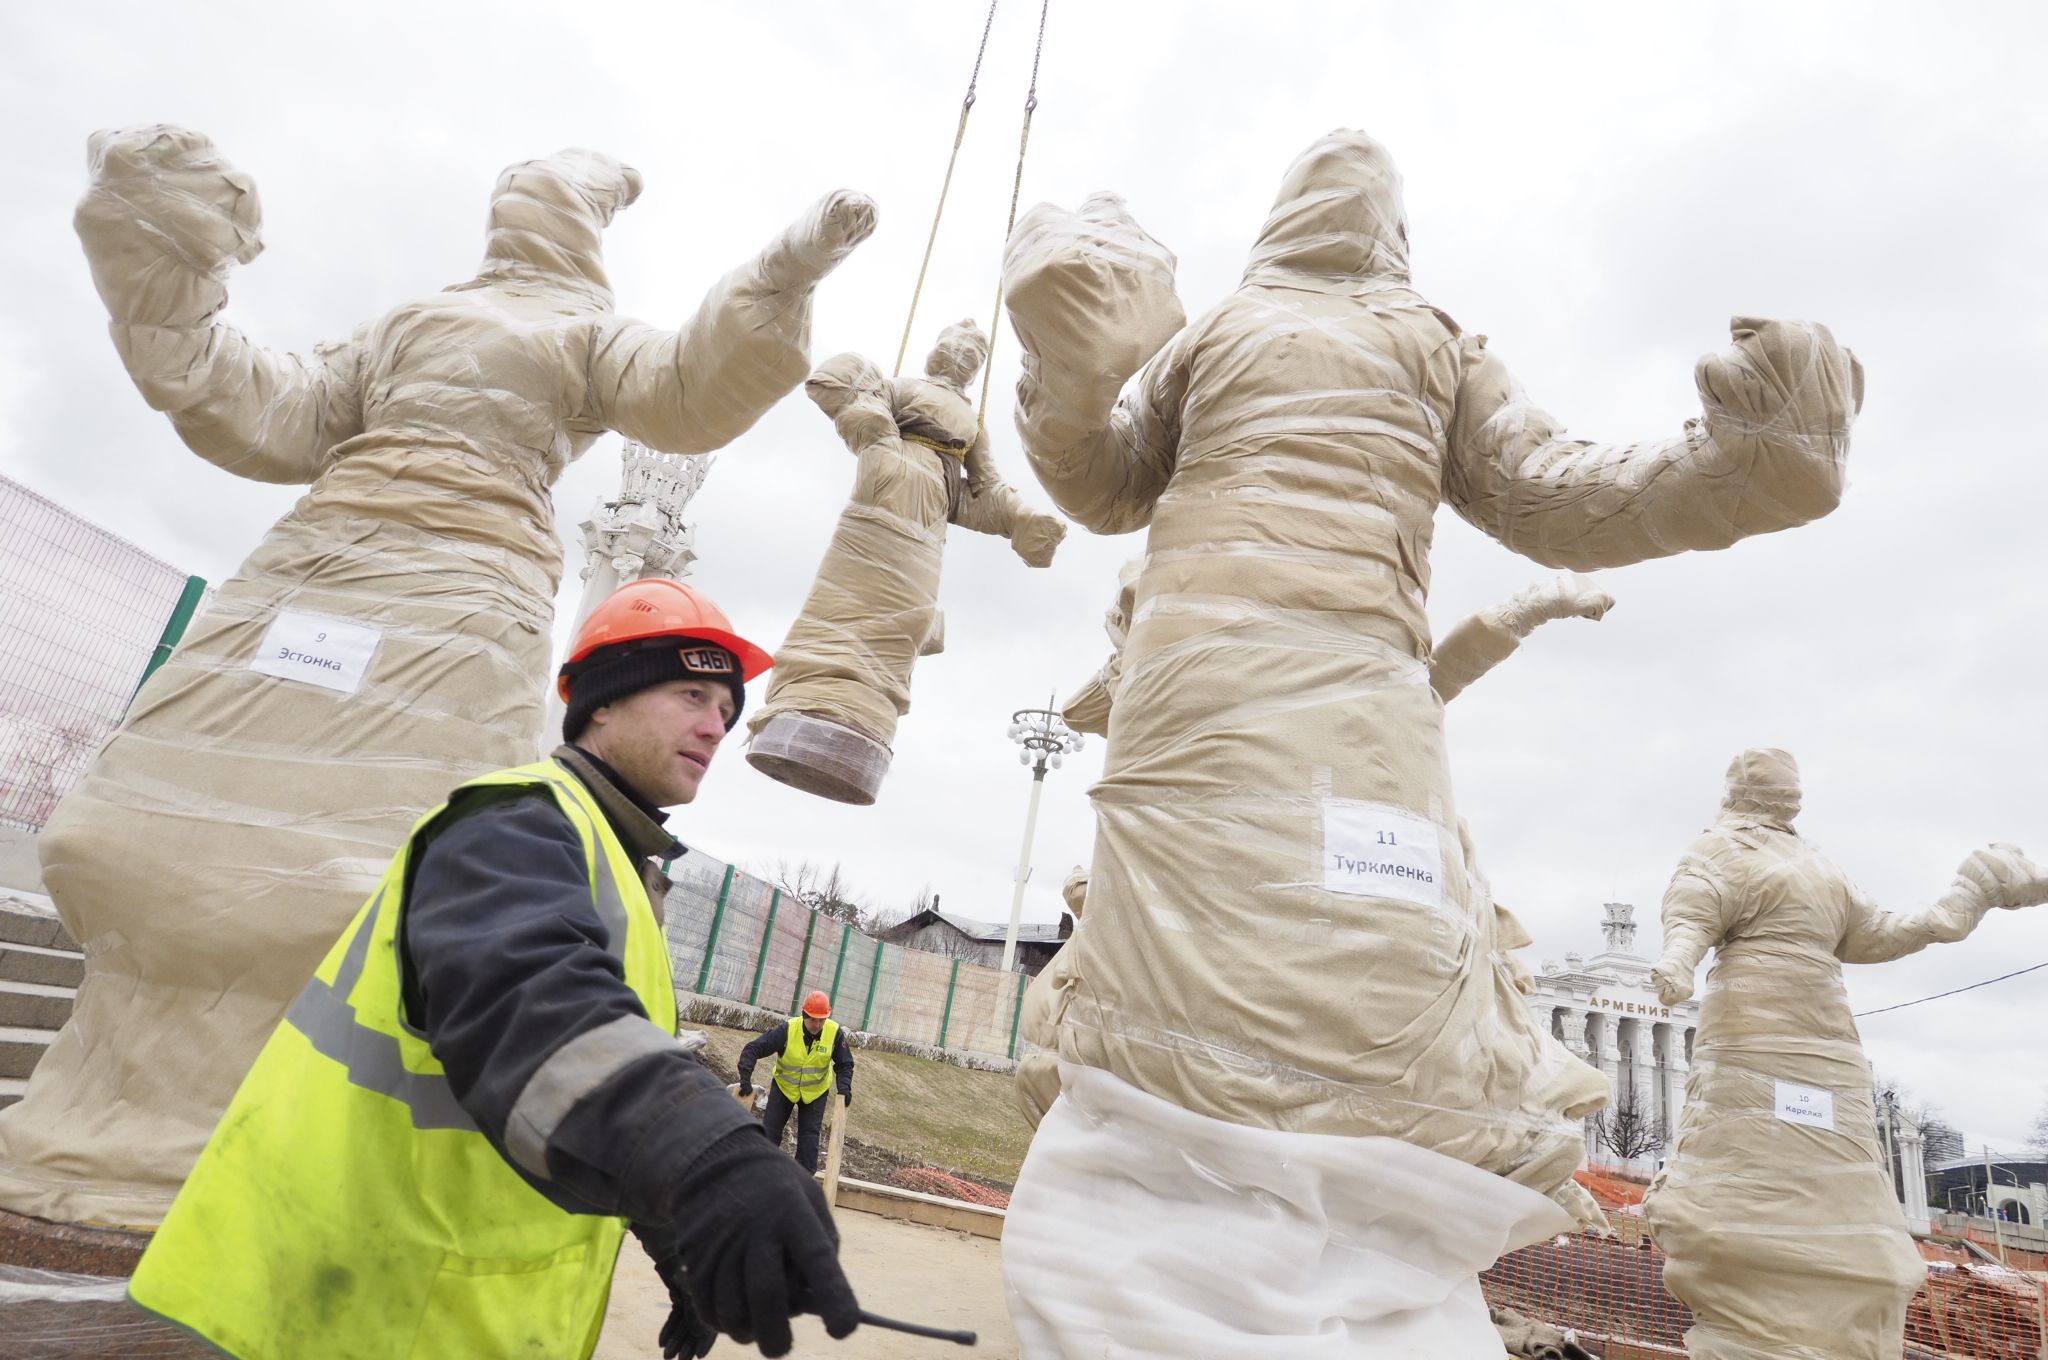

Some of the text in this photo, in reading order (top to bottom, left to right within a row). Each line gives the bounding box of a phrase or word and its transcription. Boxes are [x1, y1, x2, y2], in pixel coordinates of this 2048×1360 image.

[314, 632, 327, 643] 9
[278, 647, 342, 671] Эстонка
[1376, 830, 1398, 846] 11
[1333, 854, 1433, 884] Туркменка
[1590, 997, 1670, 1018] АРМЕНИЯ
[1799, 1095, 1809, 1103] 10
[1785, 1104, 1823, 1119] Карелка
